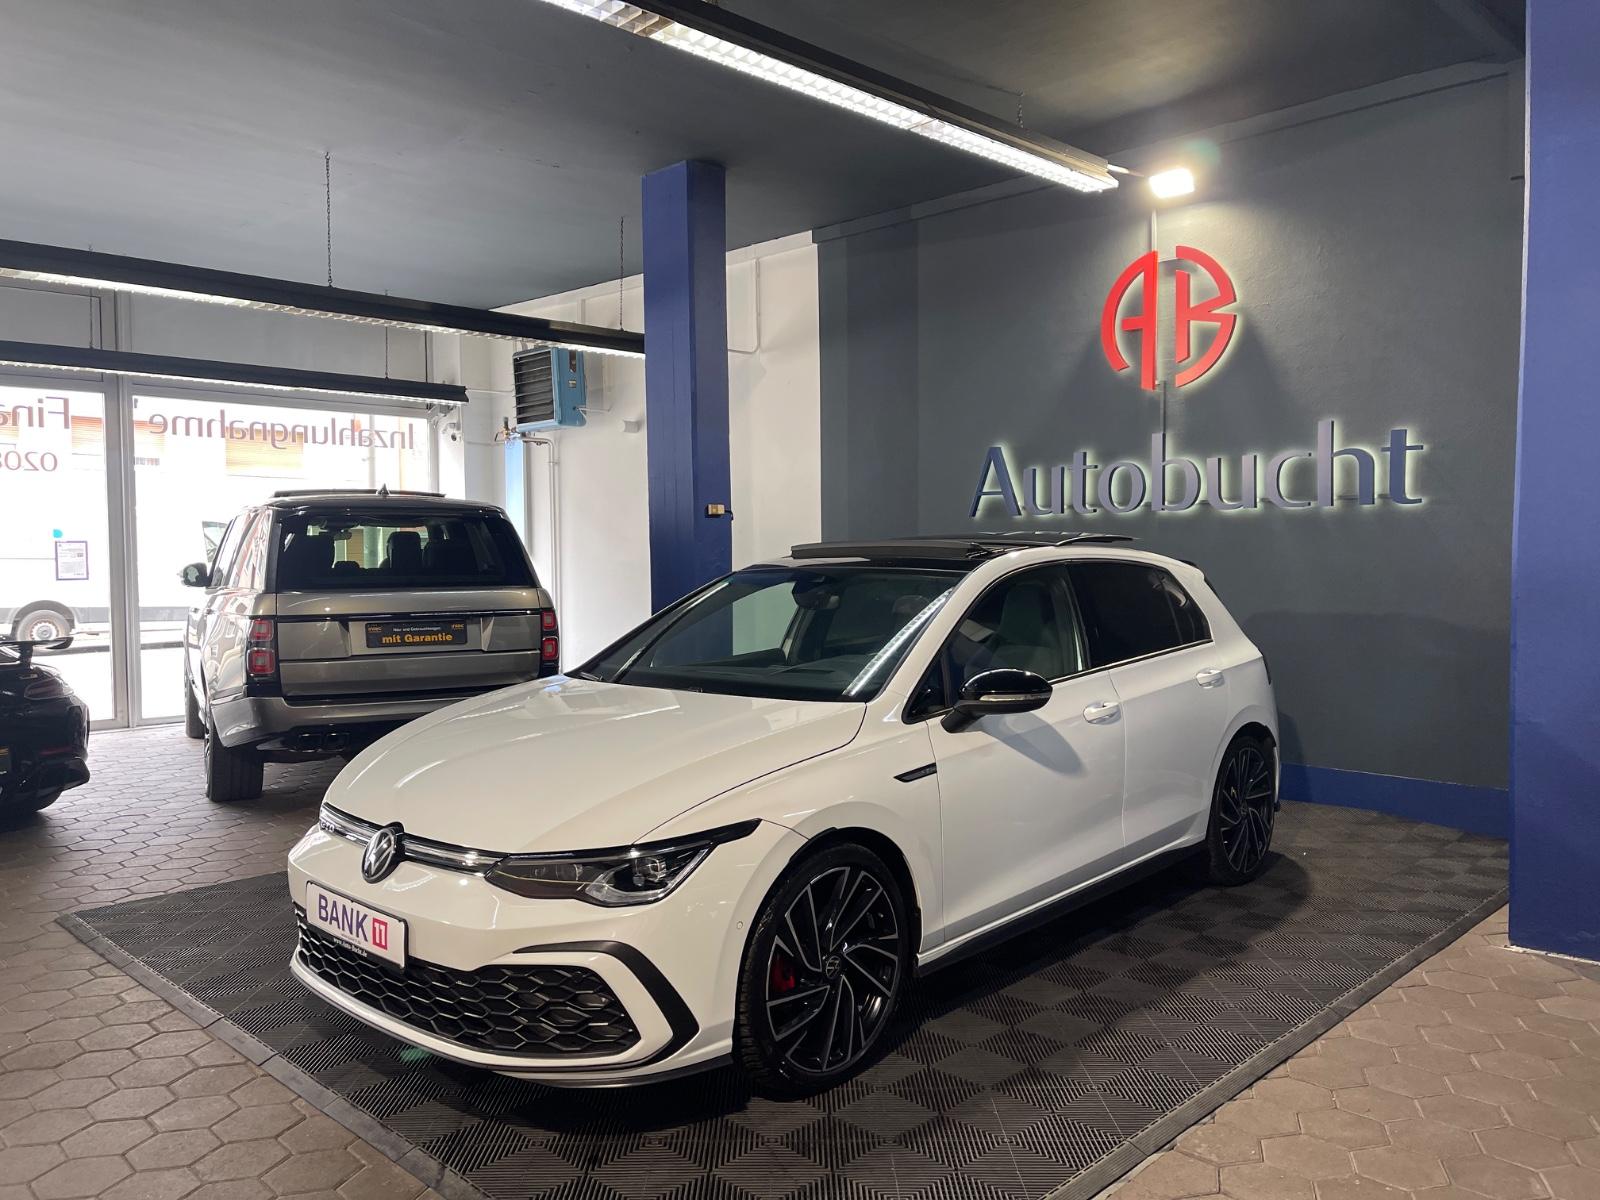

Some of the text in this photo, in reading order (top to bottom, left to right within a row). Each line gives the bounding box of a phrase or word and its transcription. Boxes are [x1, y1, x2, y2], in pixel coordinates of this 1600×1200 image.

[1101, 245, 1237, 390] AB
[967, 419, 1425, 519] Autobucht
[382, 632, 453, 644] mit Garantie
[318, 893, 369, 943] BANK
